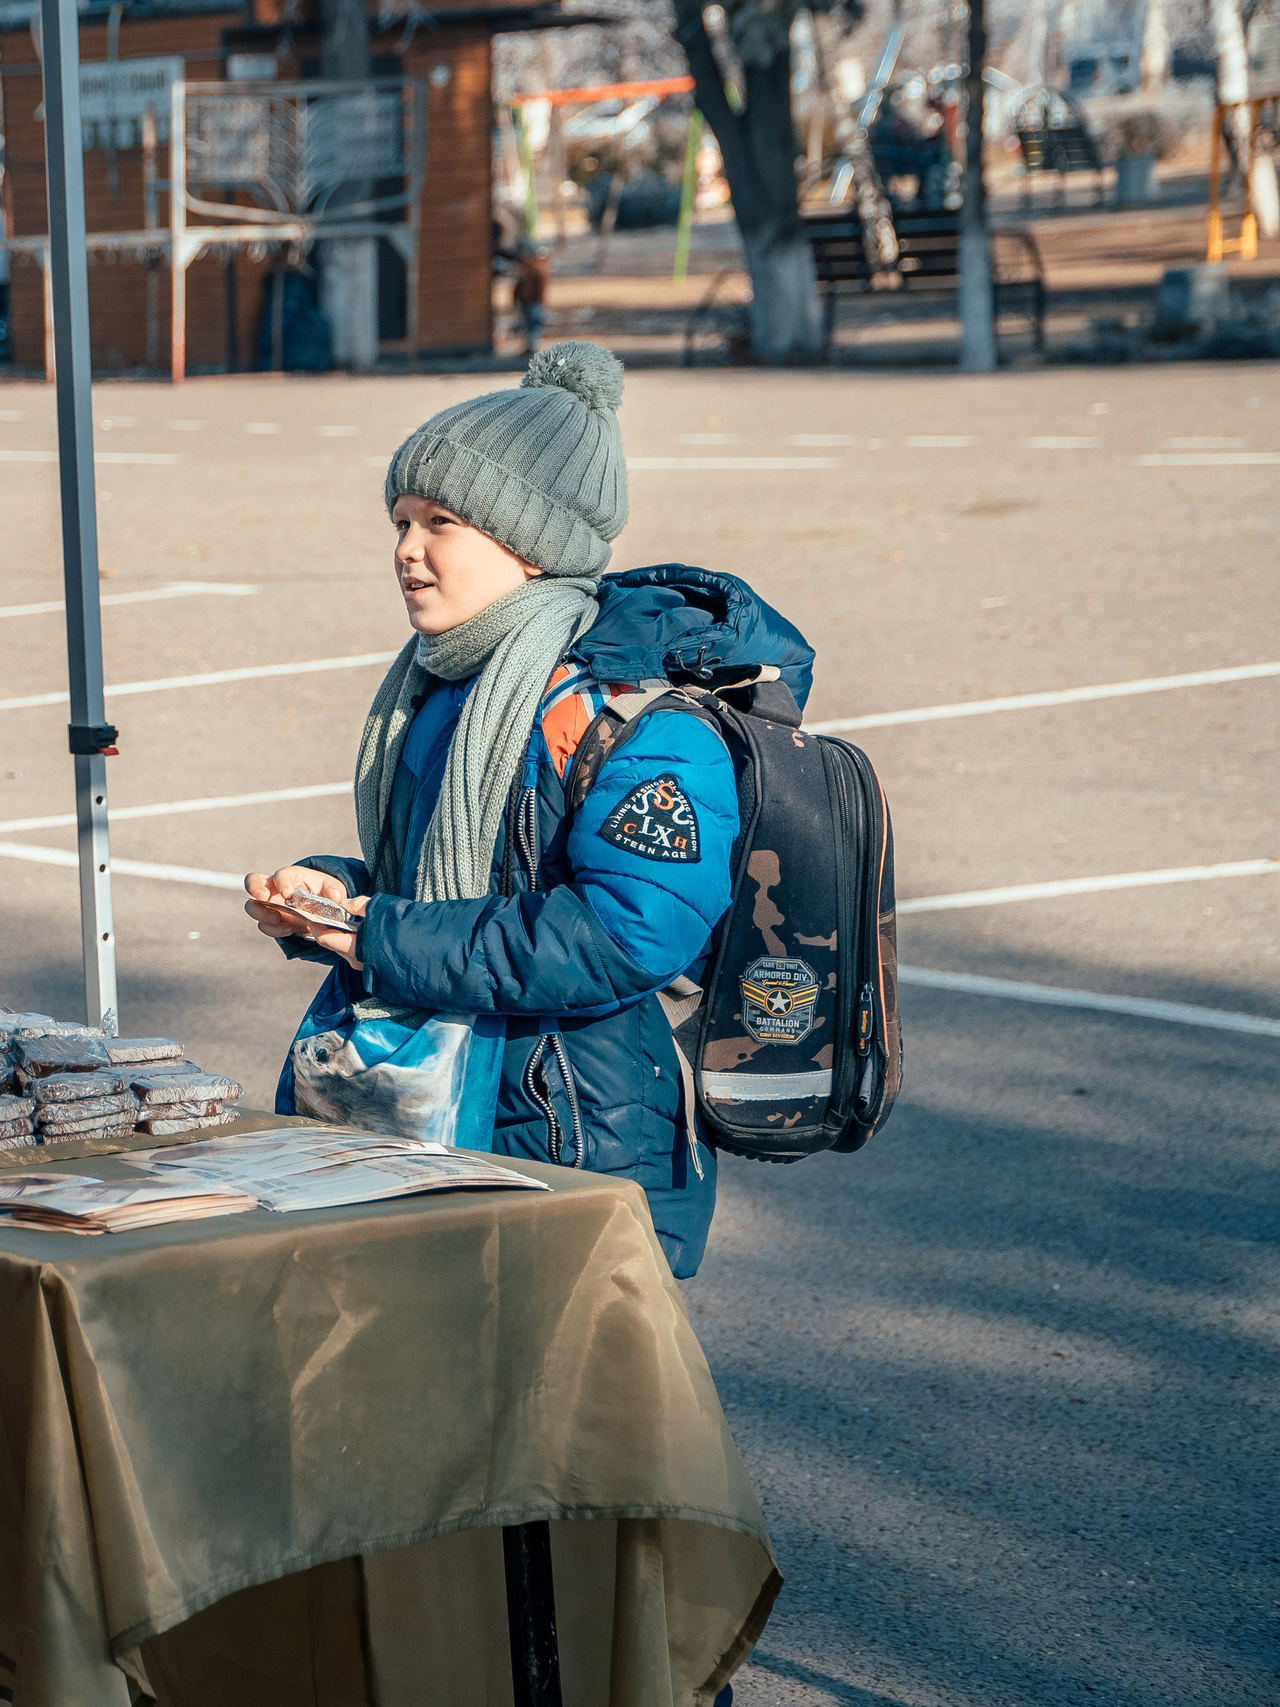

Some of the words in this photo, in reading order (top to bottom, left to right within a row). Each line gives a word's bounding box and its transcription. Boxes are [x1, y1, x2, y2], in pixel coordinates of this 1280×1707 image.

[610, 803, 632, 829] LIXING
[631, 779, 665, 803] FASHION
[668, 780, 691, 812] CLASSIC
[686, 814, 697, 852] FASHION
[615, 833, 656, 855] STEEN
[661, 850, 687, 859] AGE
[753, 970, 791, 980] ARMORED
[793, 972, 810, 982] DIV.
[756, 1017, 800, 1028] BATTALION
[759, 1026, 796, 1034] COMMAND
[861, 1010, 869, 1033] Berlingo
